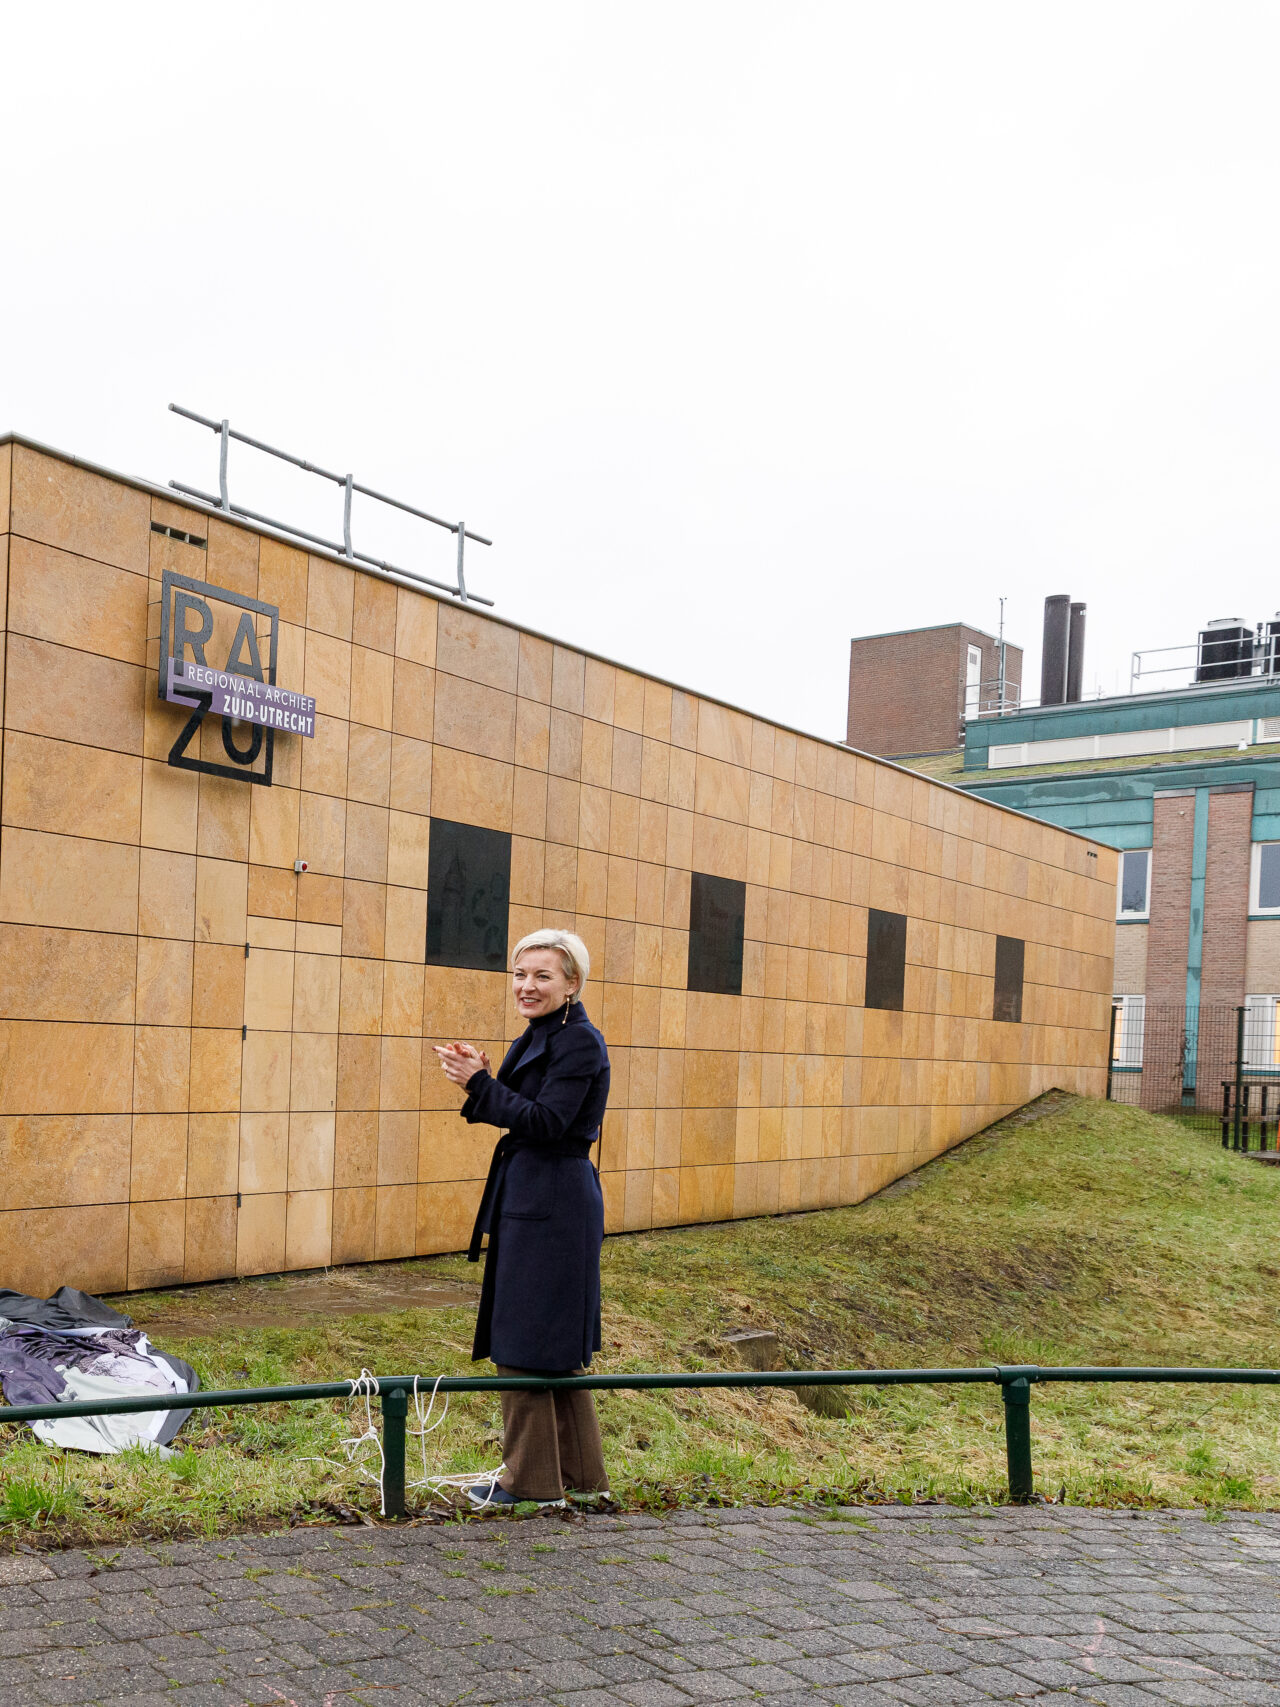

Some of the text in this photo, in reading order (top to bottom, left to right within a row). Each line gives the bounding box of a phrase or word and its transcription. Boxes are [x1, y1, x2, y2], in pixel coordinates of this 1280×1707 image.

[188, 665, 313, 712] REGIONAAL ARCHIEF
[223, 694, 313, 735] ZUID-UTRECHT
